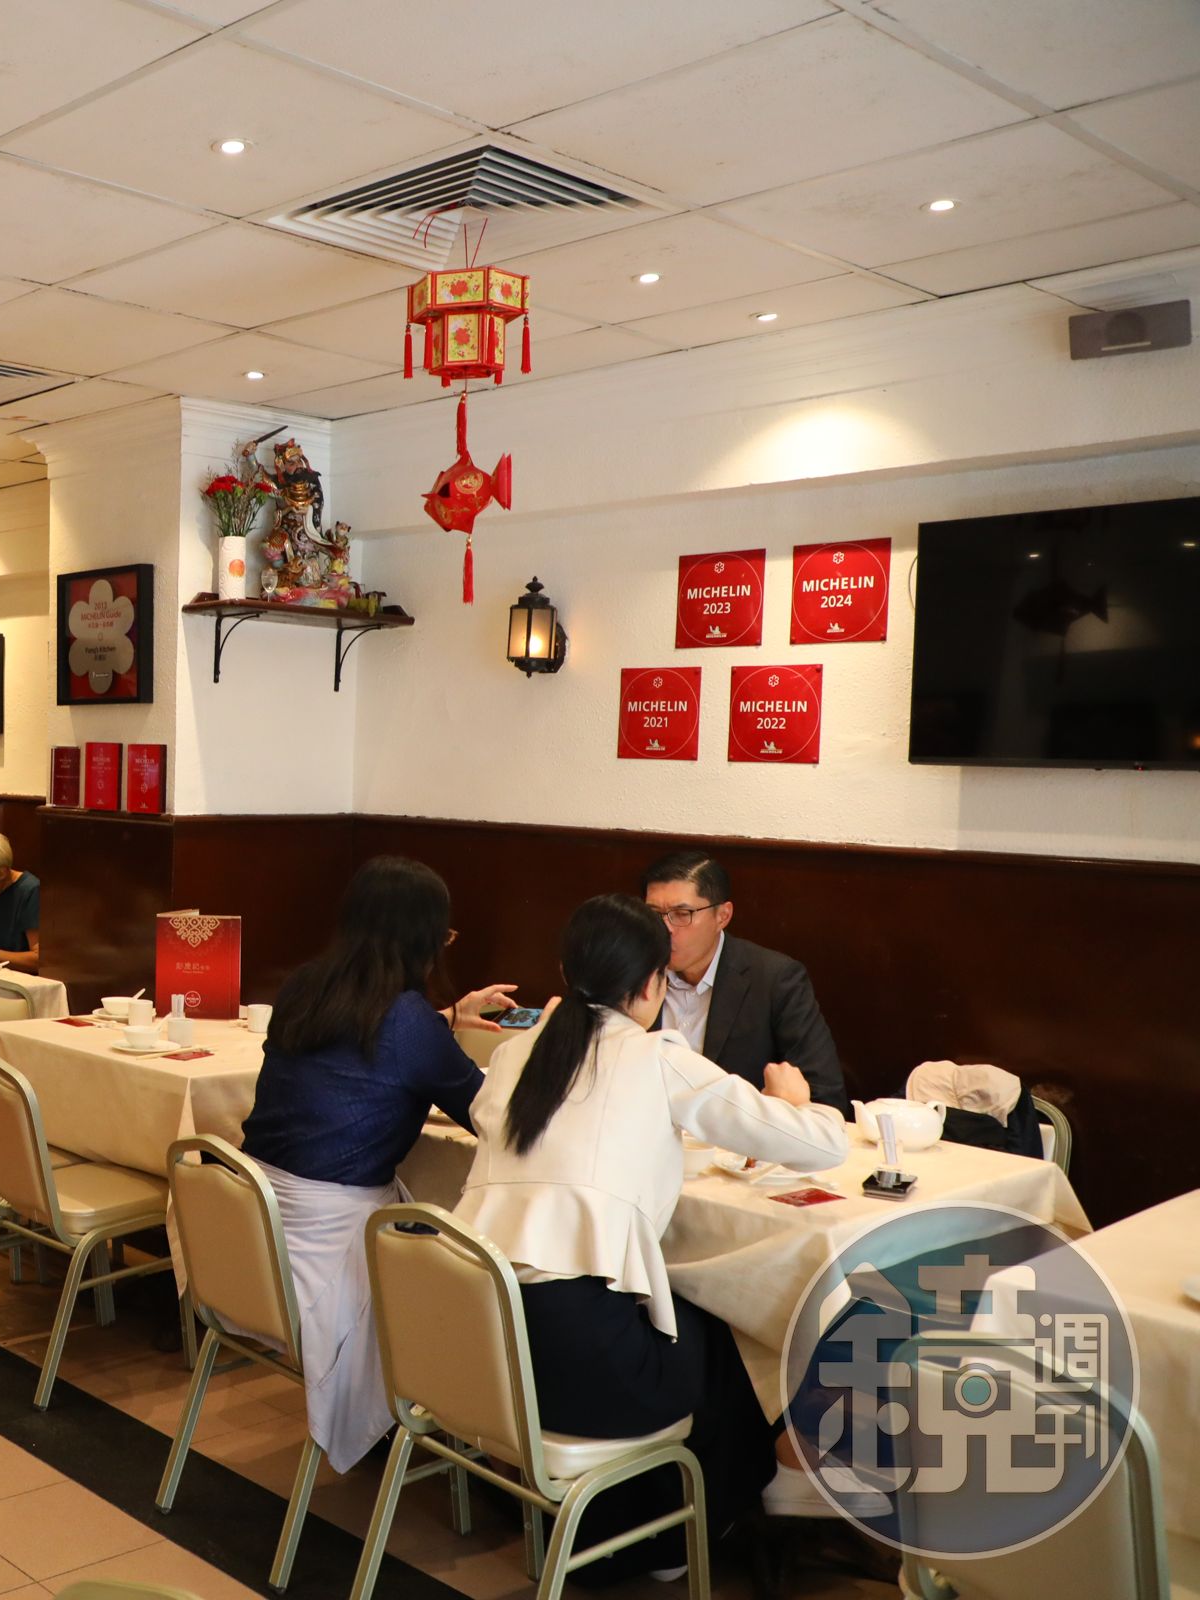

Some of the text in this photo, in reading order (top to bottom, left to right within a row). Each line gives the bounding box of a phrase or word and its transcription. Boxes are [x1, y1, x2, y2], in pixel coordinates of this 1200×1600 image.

[802, 576, 875, 592] MICHELIN
[687, 585, 751, 600] MICHELIN
[820, 595, 852, 608] 2024
[703, 602, 731, 615] 2023
[80, 611, 105, 621] MICHELIN
[627, 701, 688, 712] MICHELIN
[739, 701, 808, 713] MICHELIN
[643, 717, 668, 728] 2021
[756, 717, 787, 730] 2022
